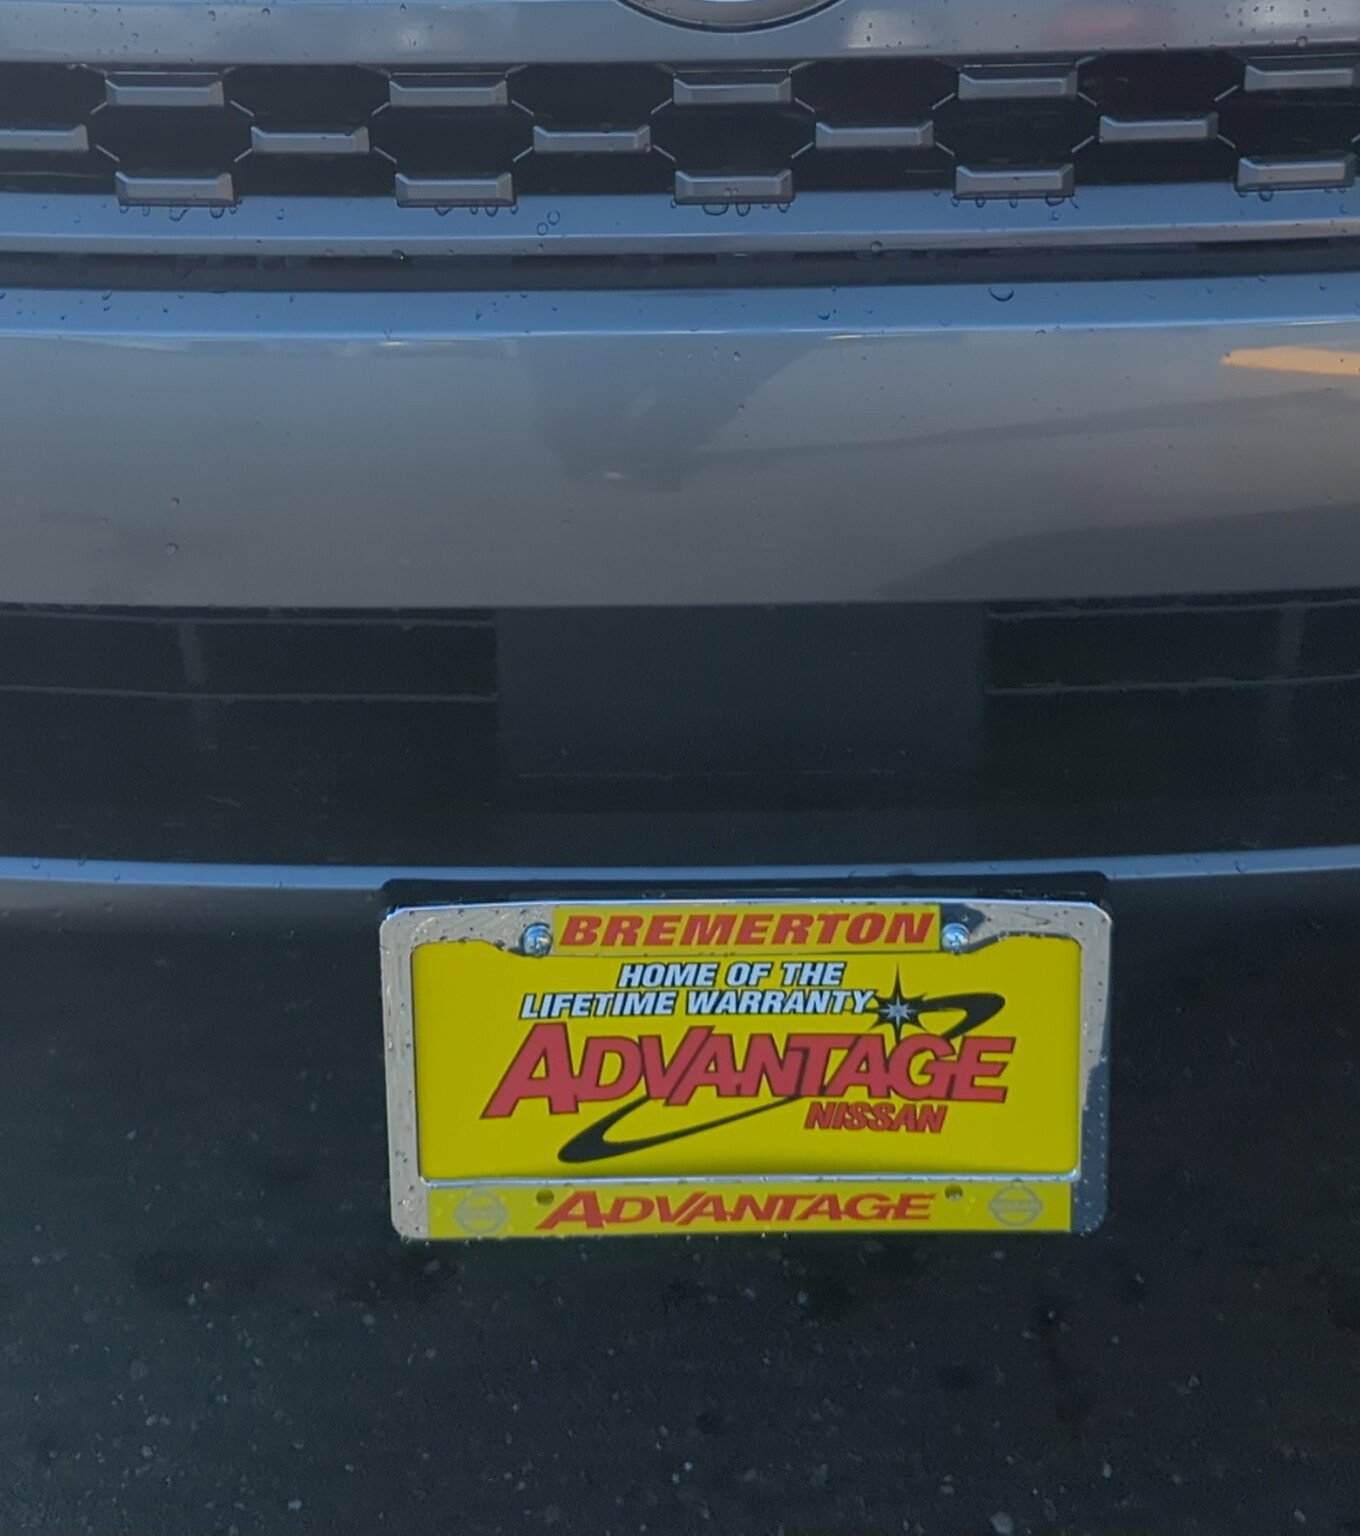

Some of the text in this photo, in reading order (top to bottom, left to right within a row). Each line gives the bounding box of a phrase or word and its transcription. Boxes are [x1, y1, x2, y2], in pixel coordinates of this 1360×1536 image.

[558, 911, 936, 947] BREMERTON
[616, 960, 847, 989] HOME OF THE
[518, 988, 879, 1020] LIFETIME WARRANTY
[478, 1022, 1017, 1120] ADVANTAGE
[803, 1100, 949, 1134] NISSAN
[534, 1190, 938, 1230] ADVANTAGE
